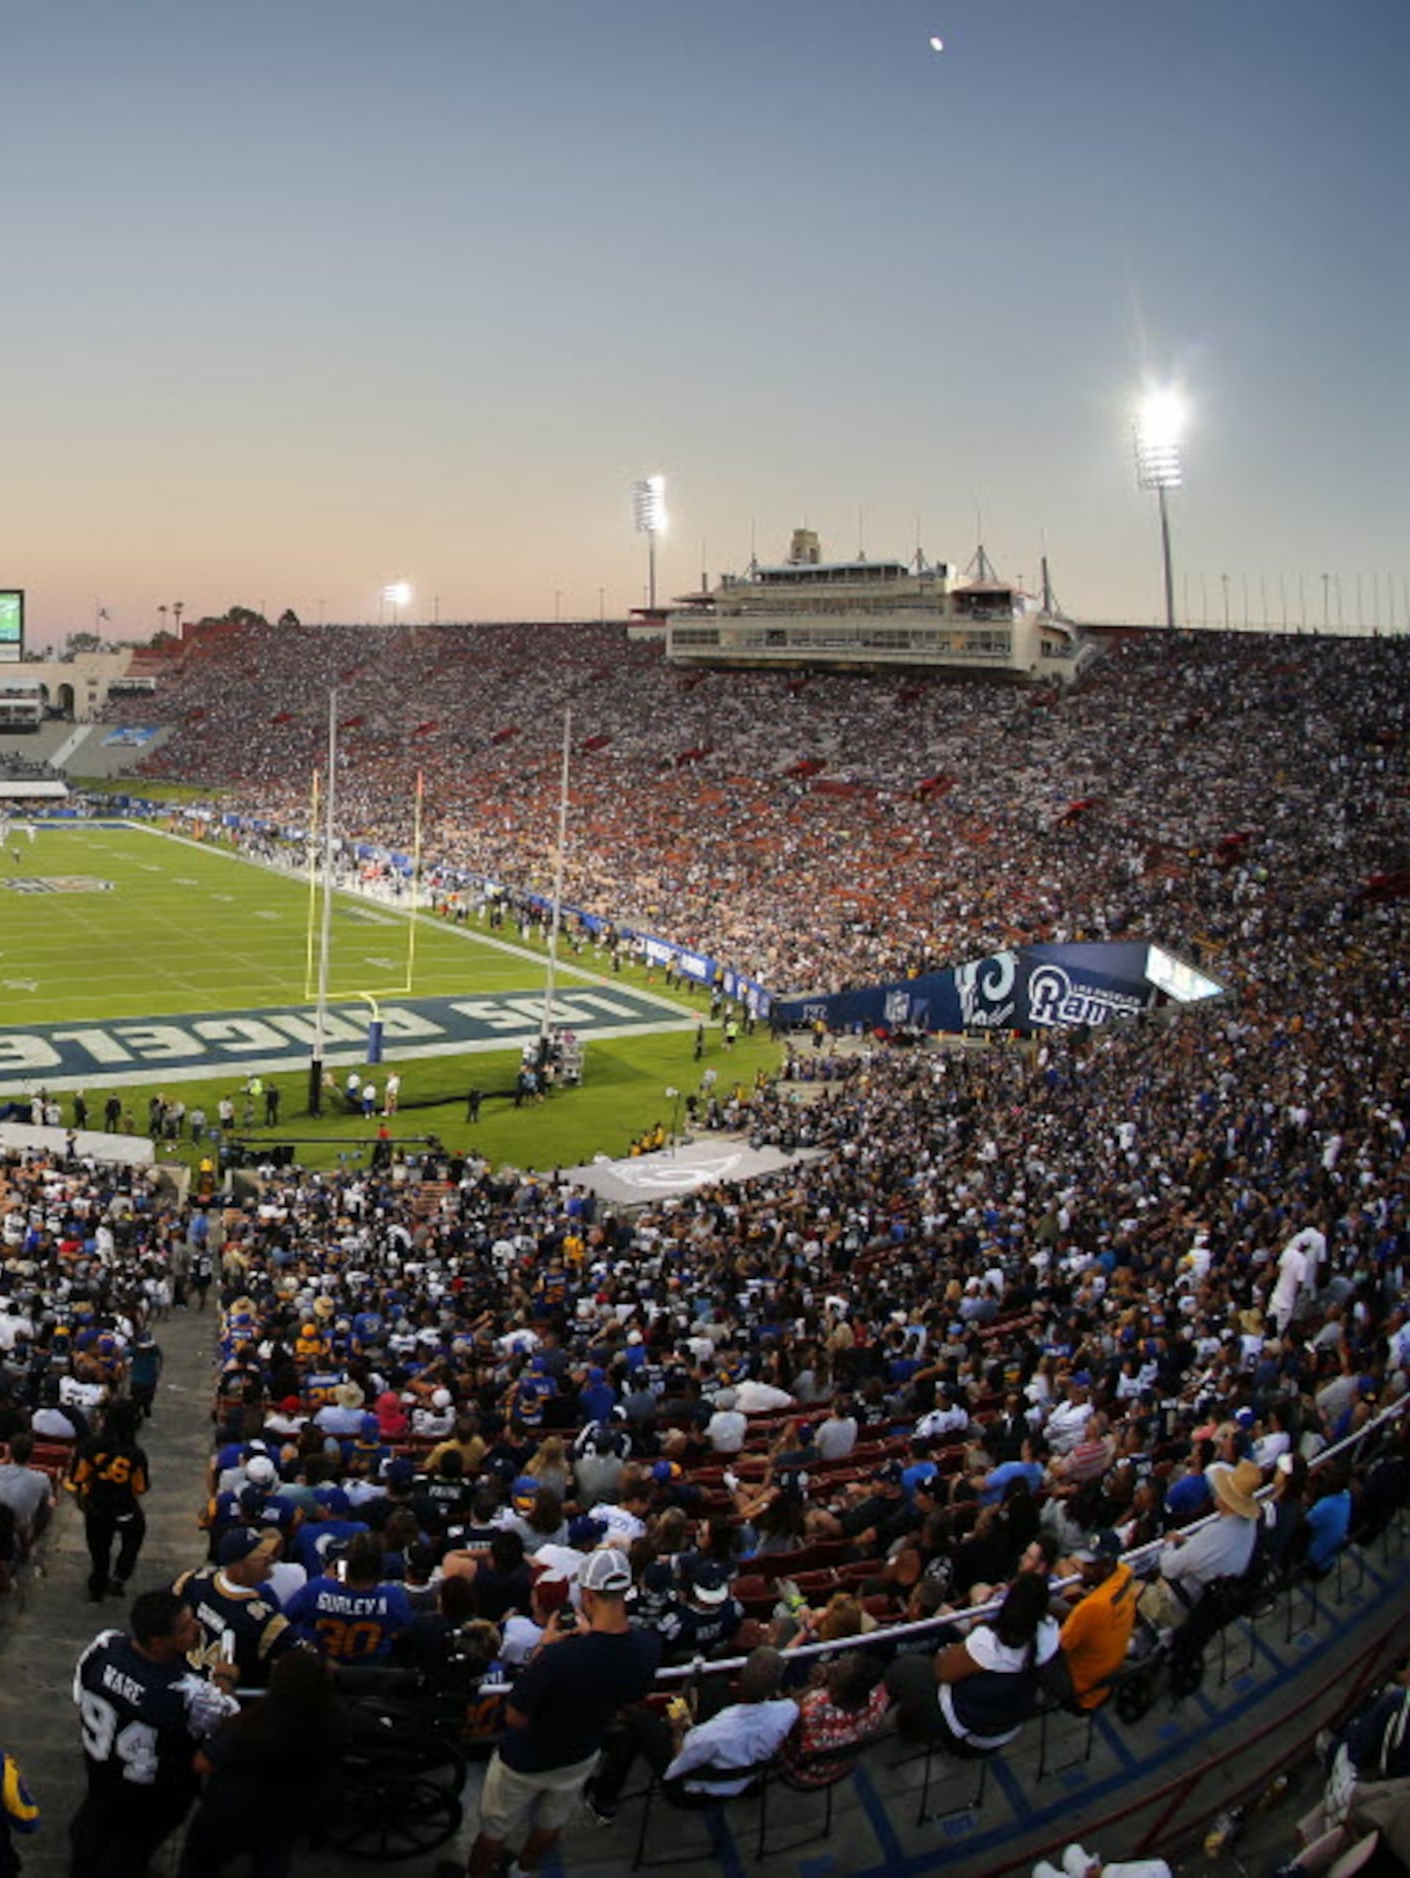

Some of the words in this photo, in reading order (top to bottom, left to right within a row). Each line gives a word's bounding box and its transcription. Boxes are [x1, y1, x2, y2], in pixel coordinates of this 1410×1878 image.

[450, 993, 643, 1029] LOS
[313, 1616, 382, 1658] 30
[79, 1688, 160, 1786] 94
